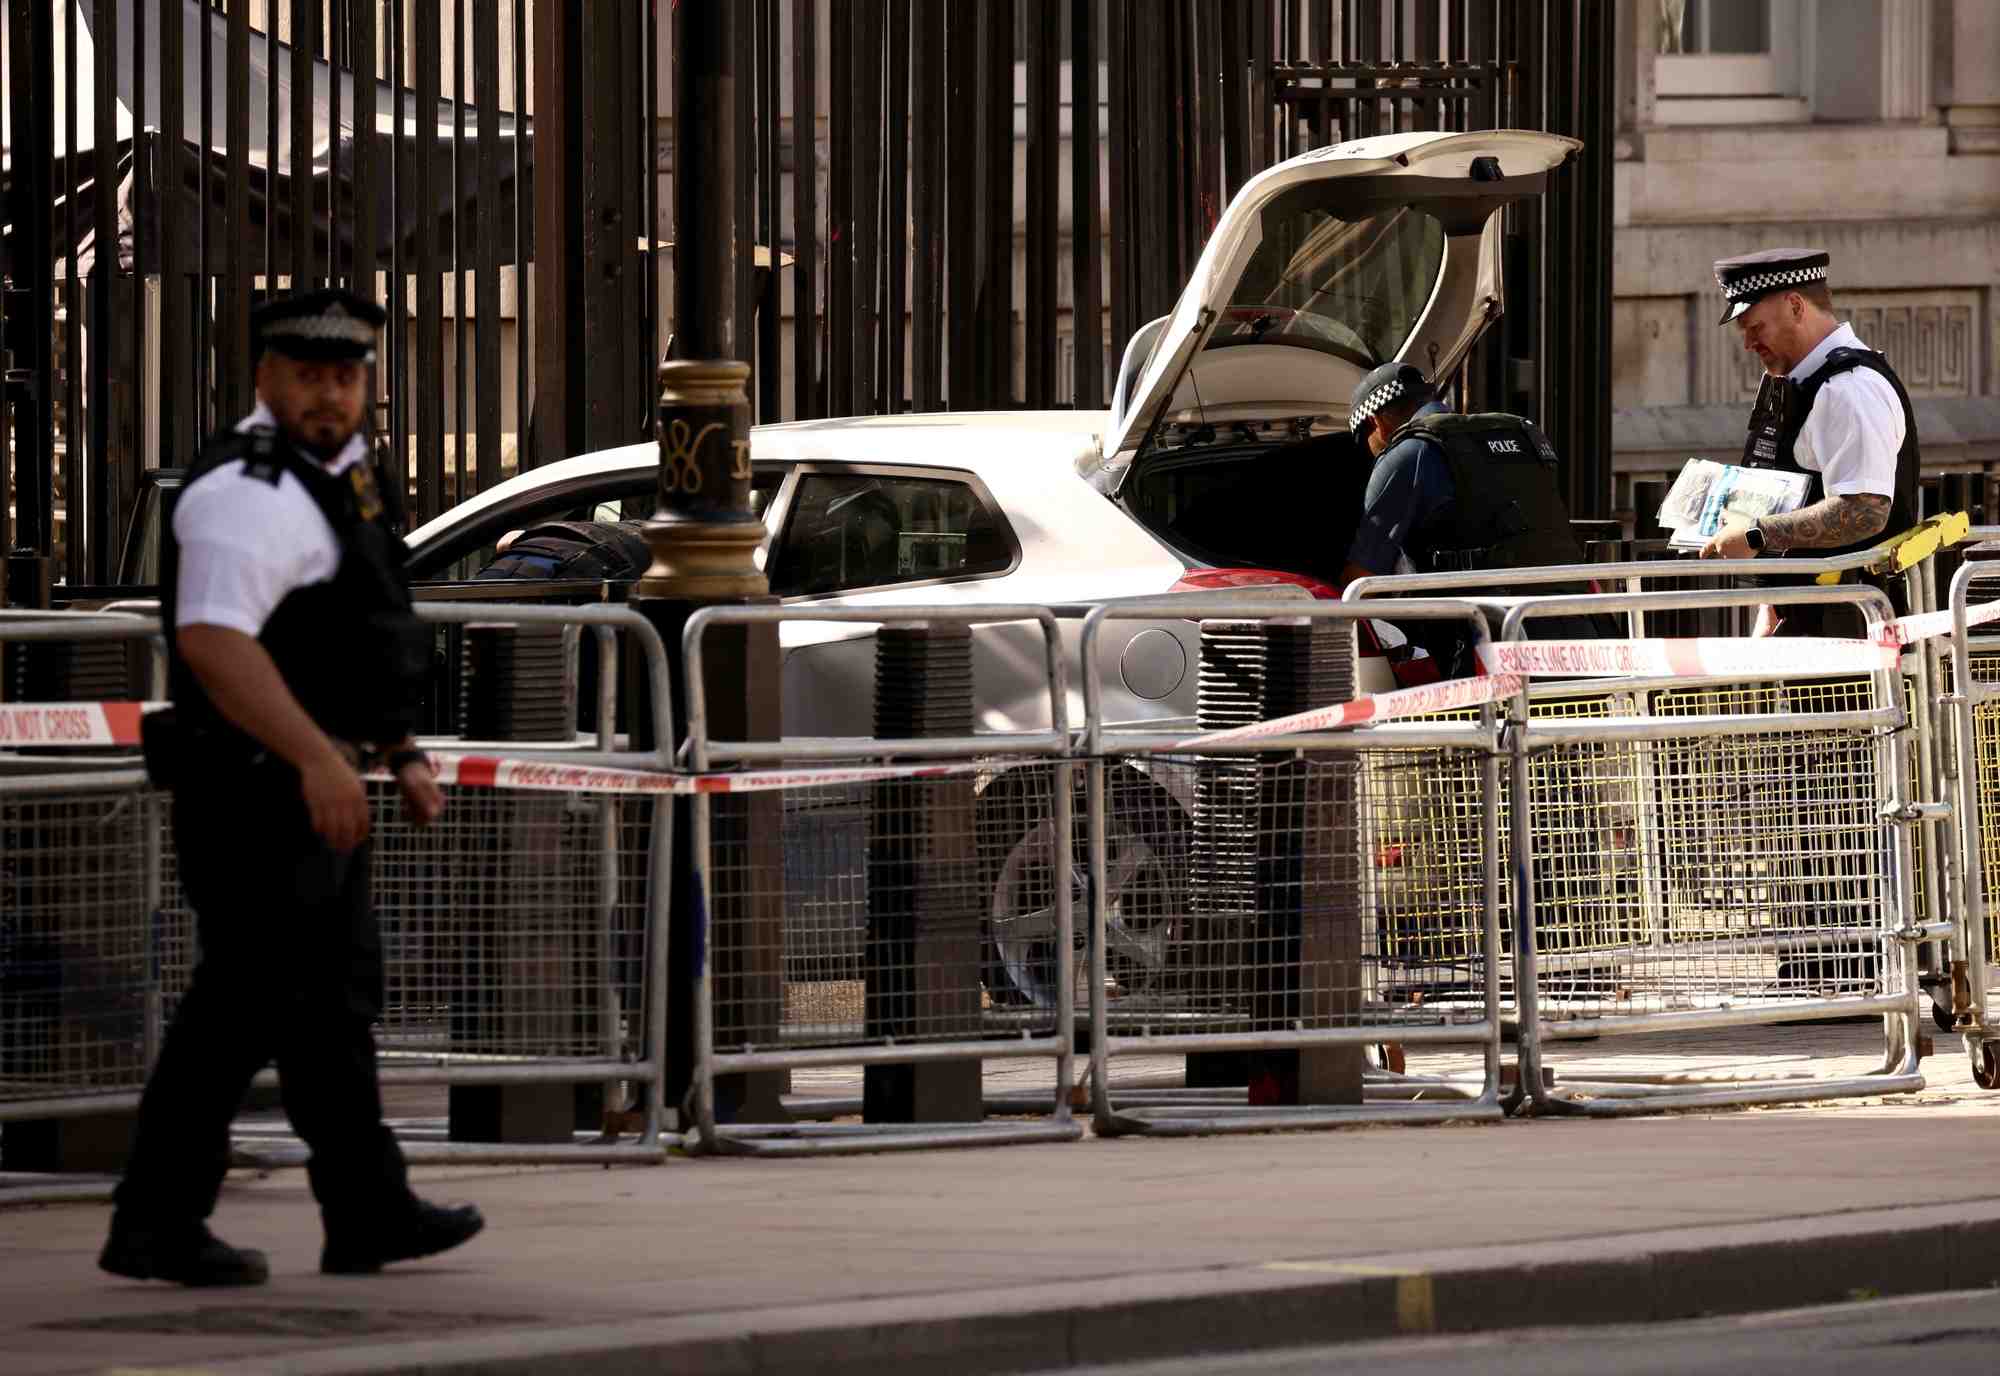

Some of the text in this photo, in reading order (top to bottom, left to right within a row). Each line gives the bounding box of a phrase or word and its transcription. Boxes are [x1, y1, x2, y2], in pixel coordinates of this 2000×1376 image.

[1488, 440, 1521, 453] POLICE
[1542, 646, 1570, 672] LINE
[1570, 646, 1589, 672] DO
[1589, 646, 1614, 672] NOT
[14, 710, 40, 738] NOT
[44, 710, 91, 739] CROSS
